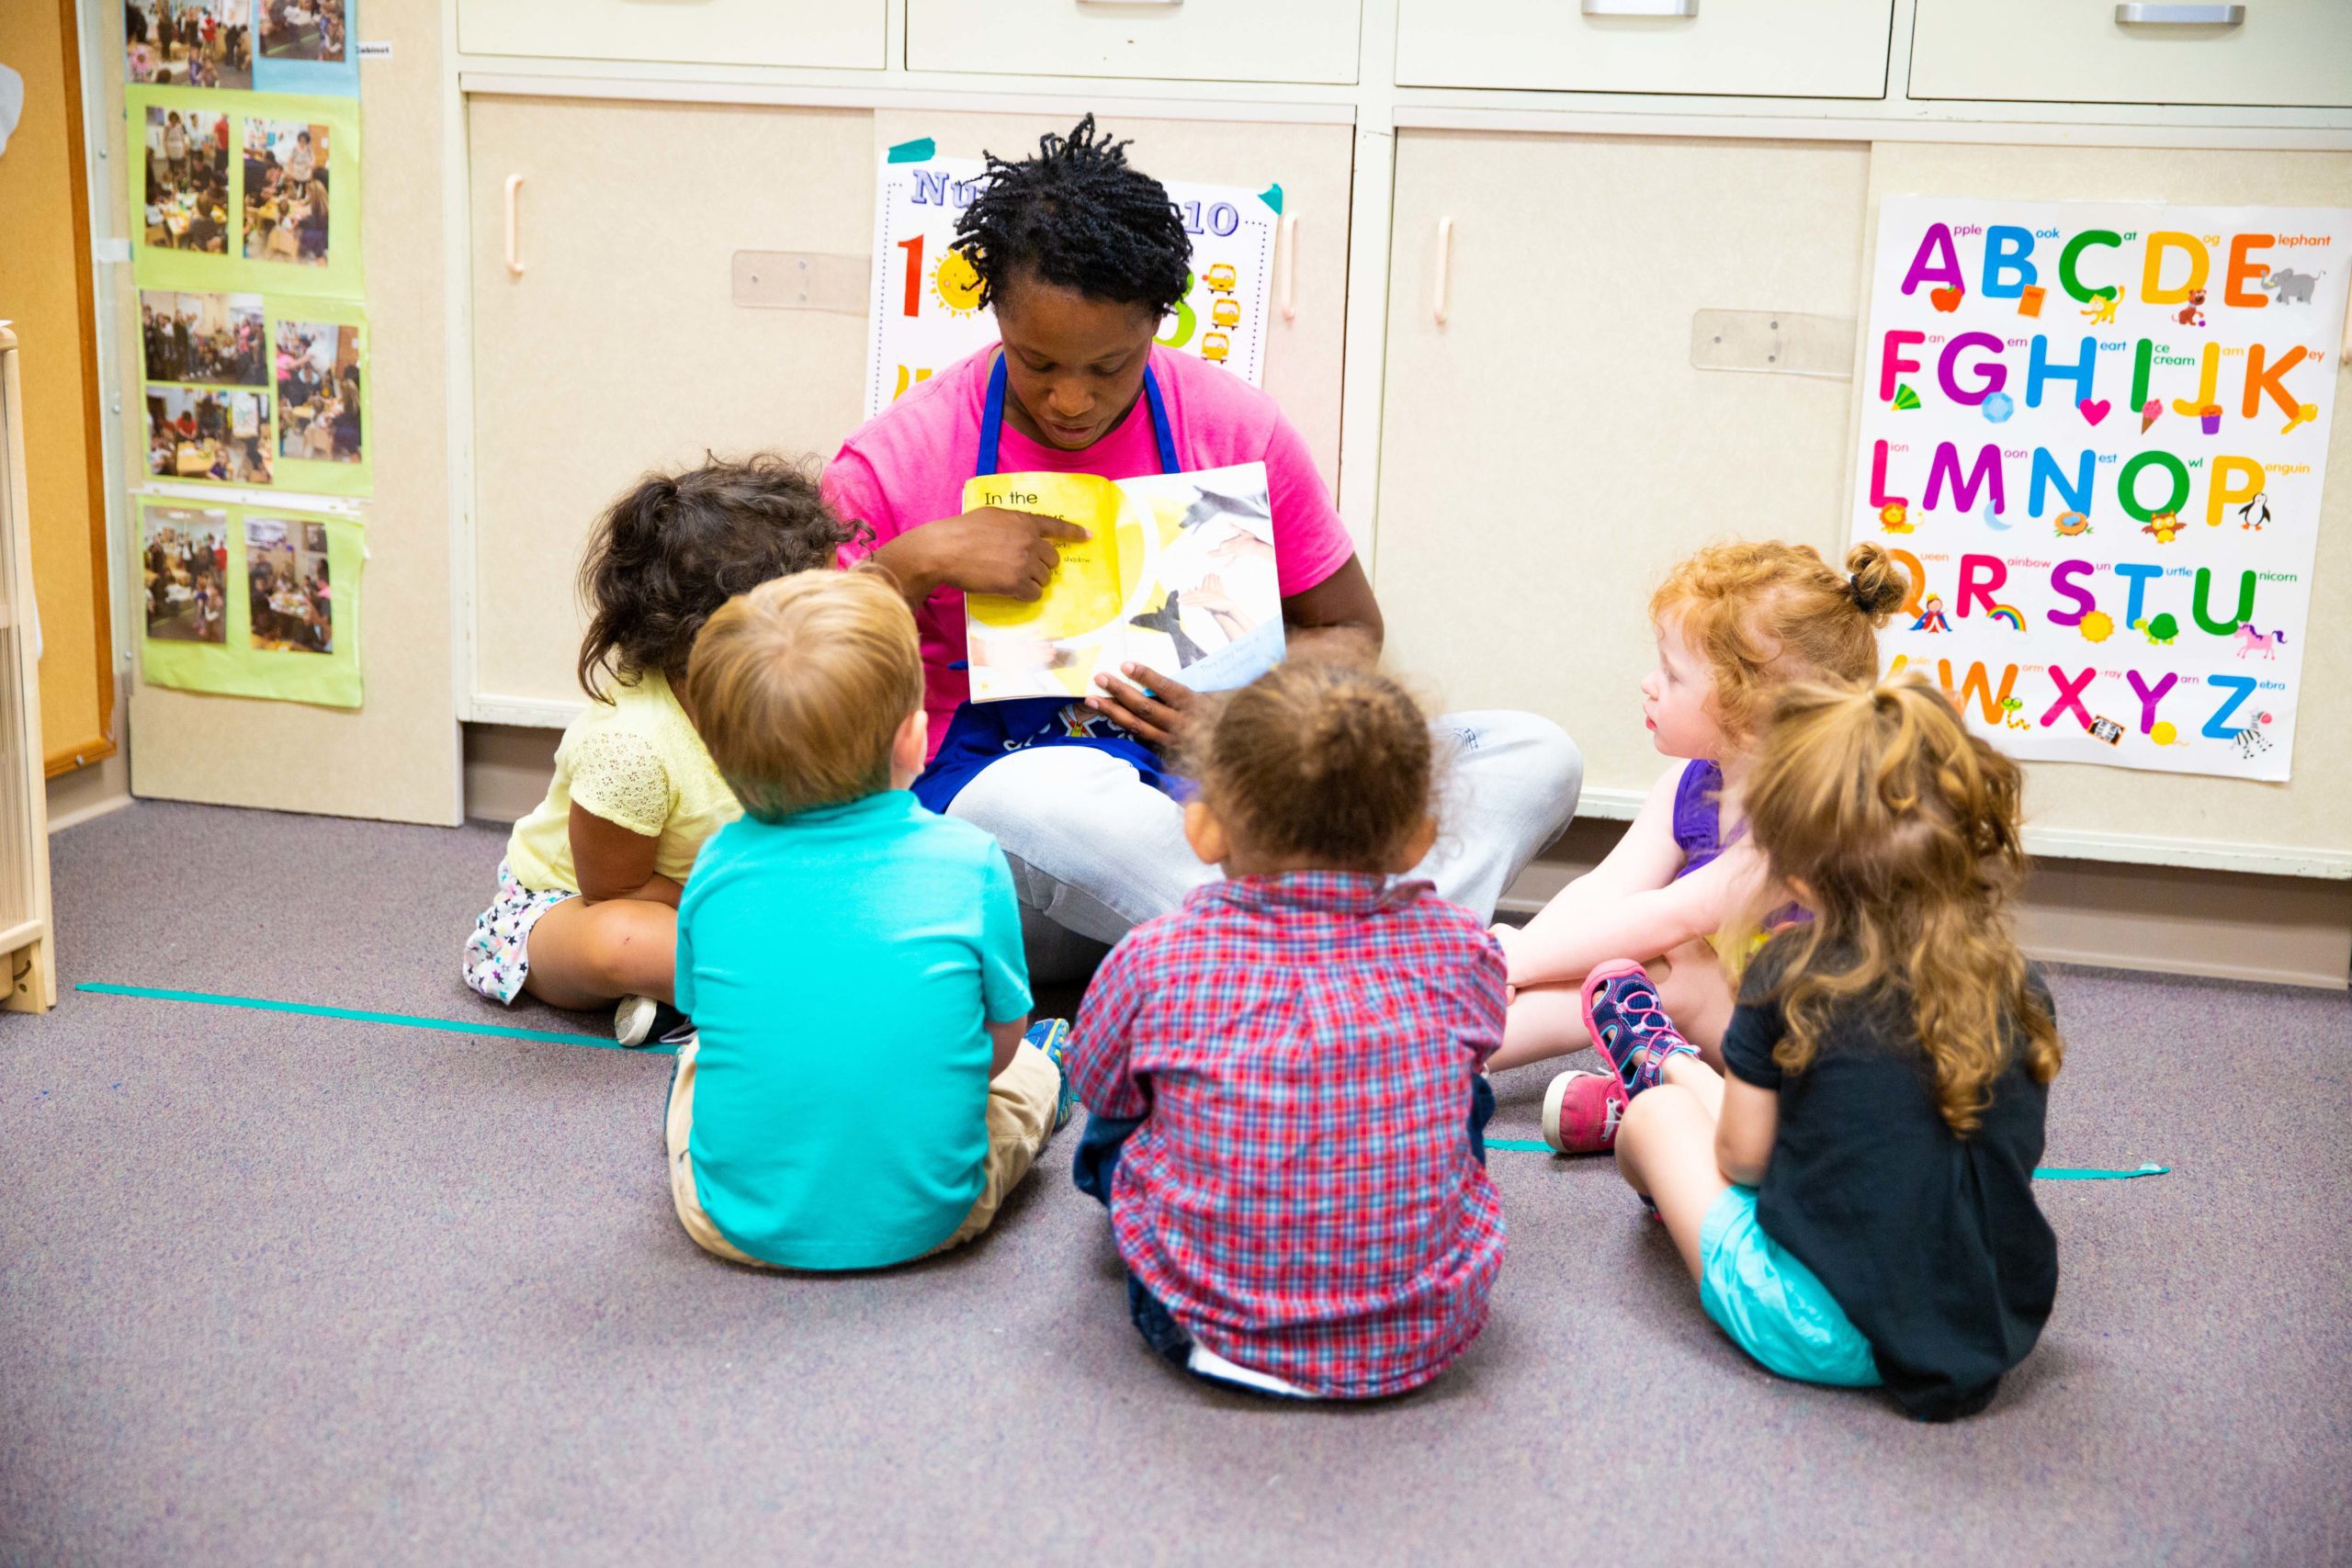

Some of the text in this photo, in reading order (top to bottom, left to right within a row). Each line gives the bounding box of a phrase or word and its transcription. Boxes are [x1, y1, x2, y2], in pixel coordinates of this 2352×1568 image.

[898, 233, 923, 318] 1
[985, 491, 1038, 505] In the
